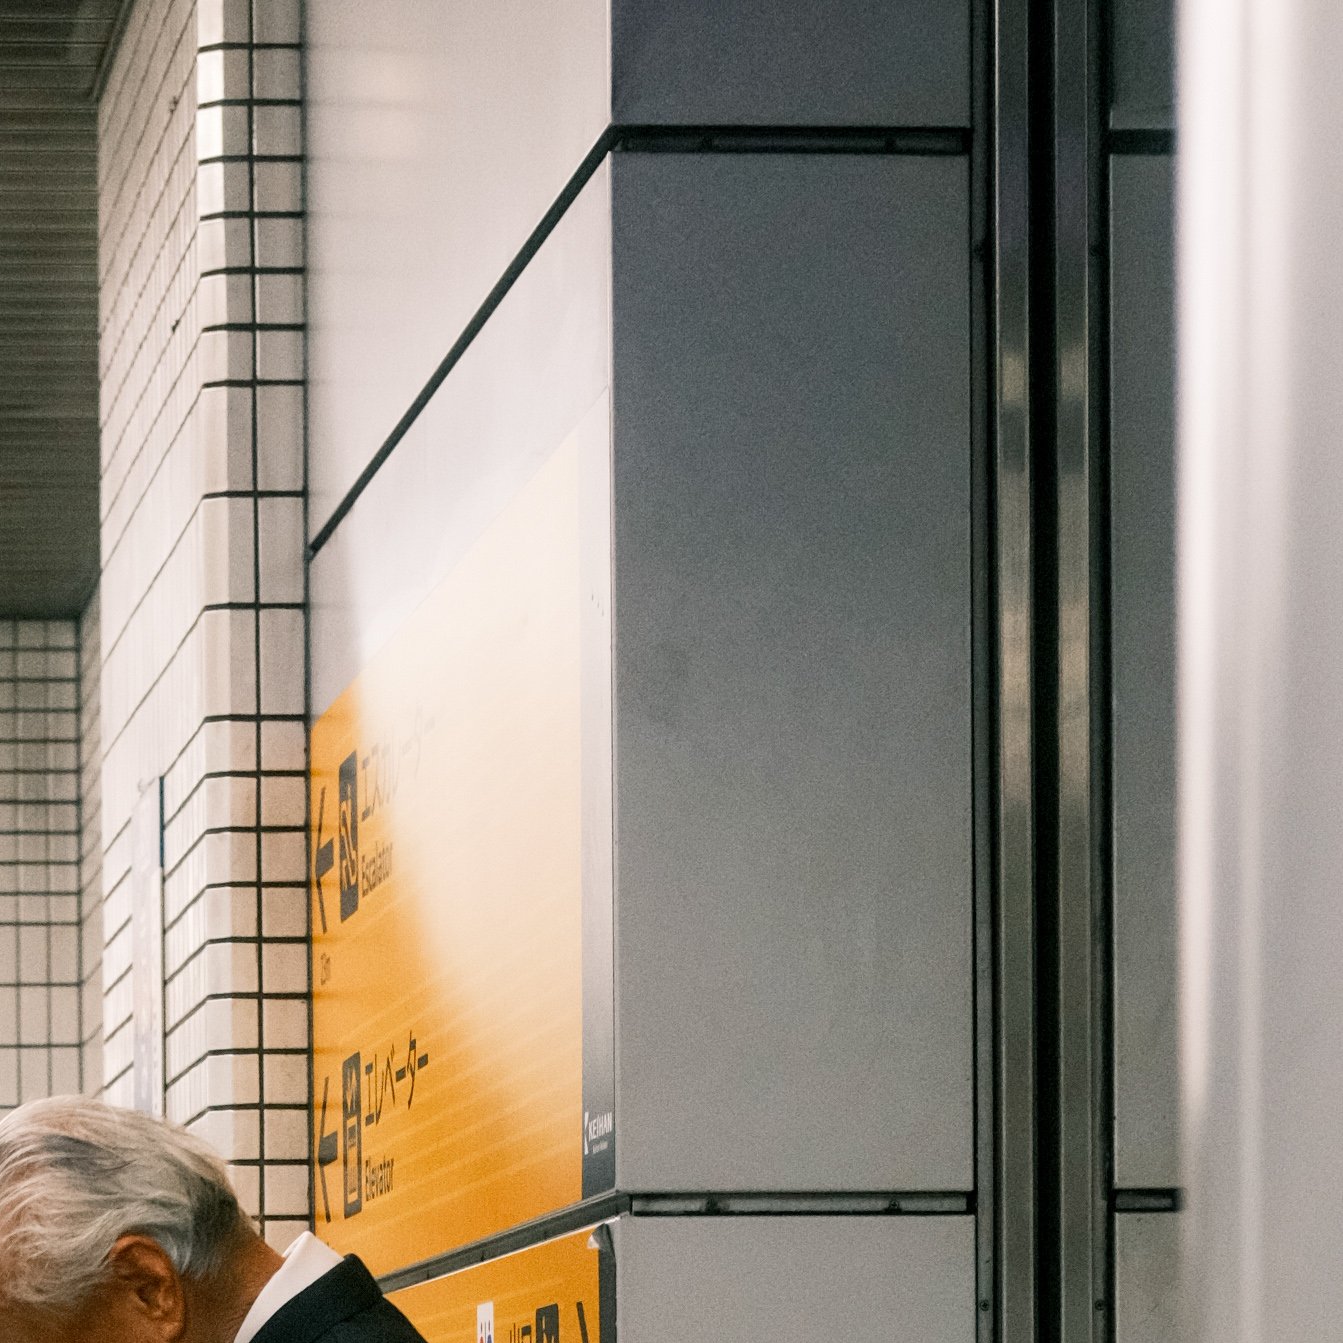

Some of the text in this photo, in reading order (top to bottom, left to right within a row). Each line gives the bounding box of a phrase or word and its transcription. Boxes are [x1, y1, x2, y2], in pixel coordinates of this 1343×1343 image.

[361, 839, 394, 898] Escalator
[364, 1029, 429, 1126] エレベーター
[588, 1111, 613, 1142] KEIHAN
[365, 1155, 394, 1201] Elevator
